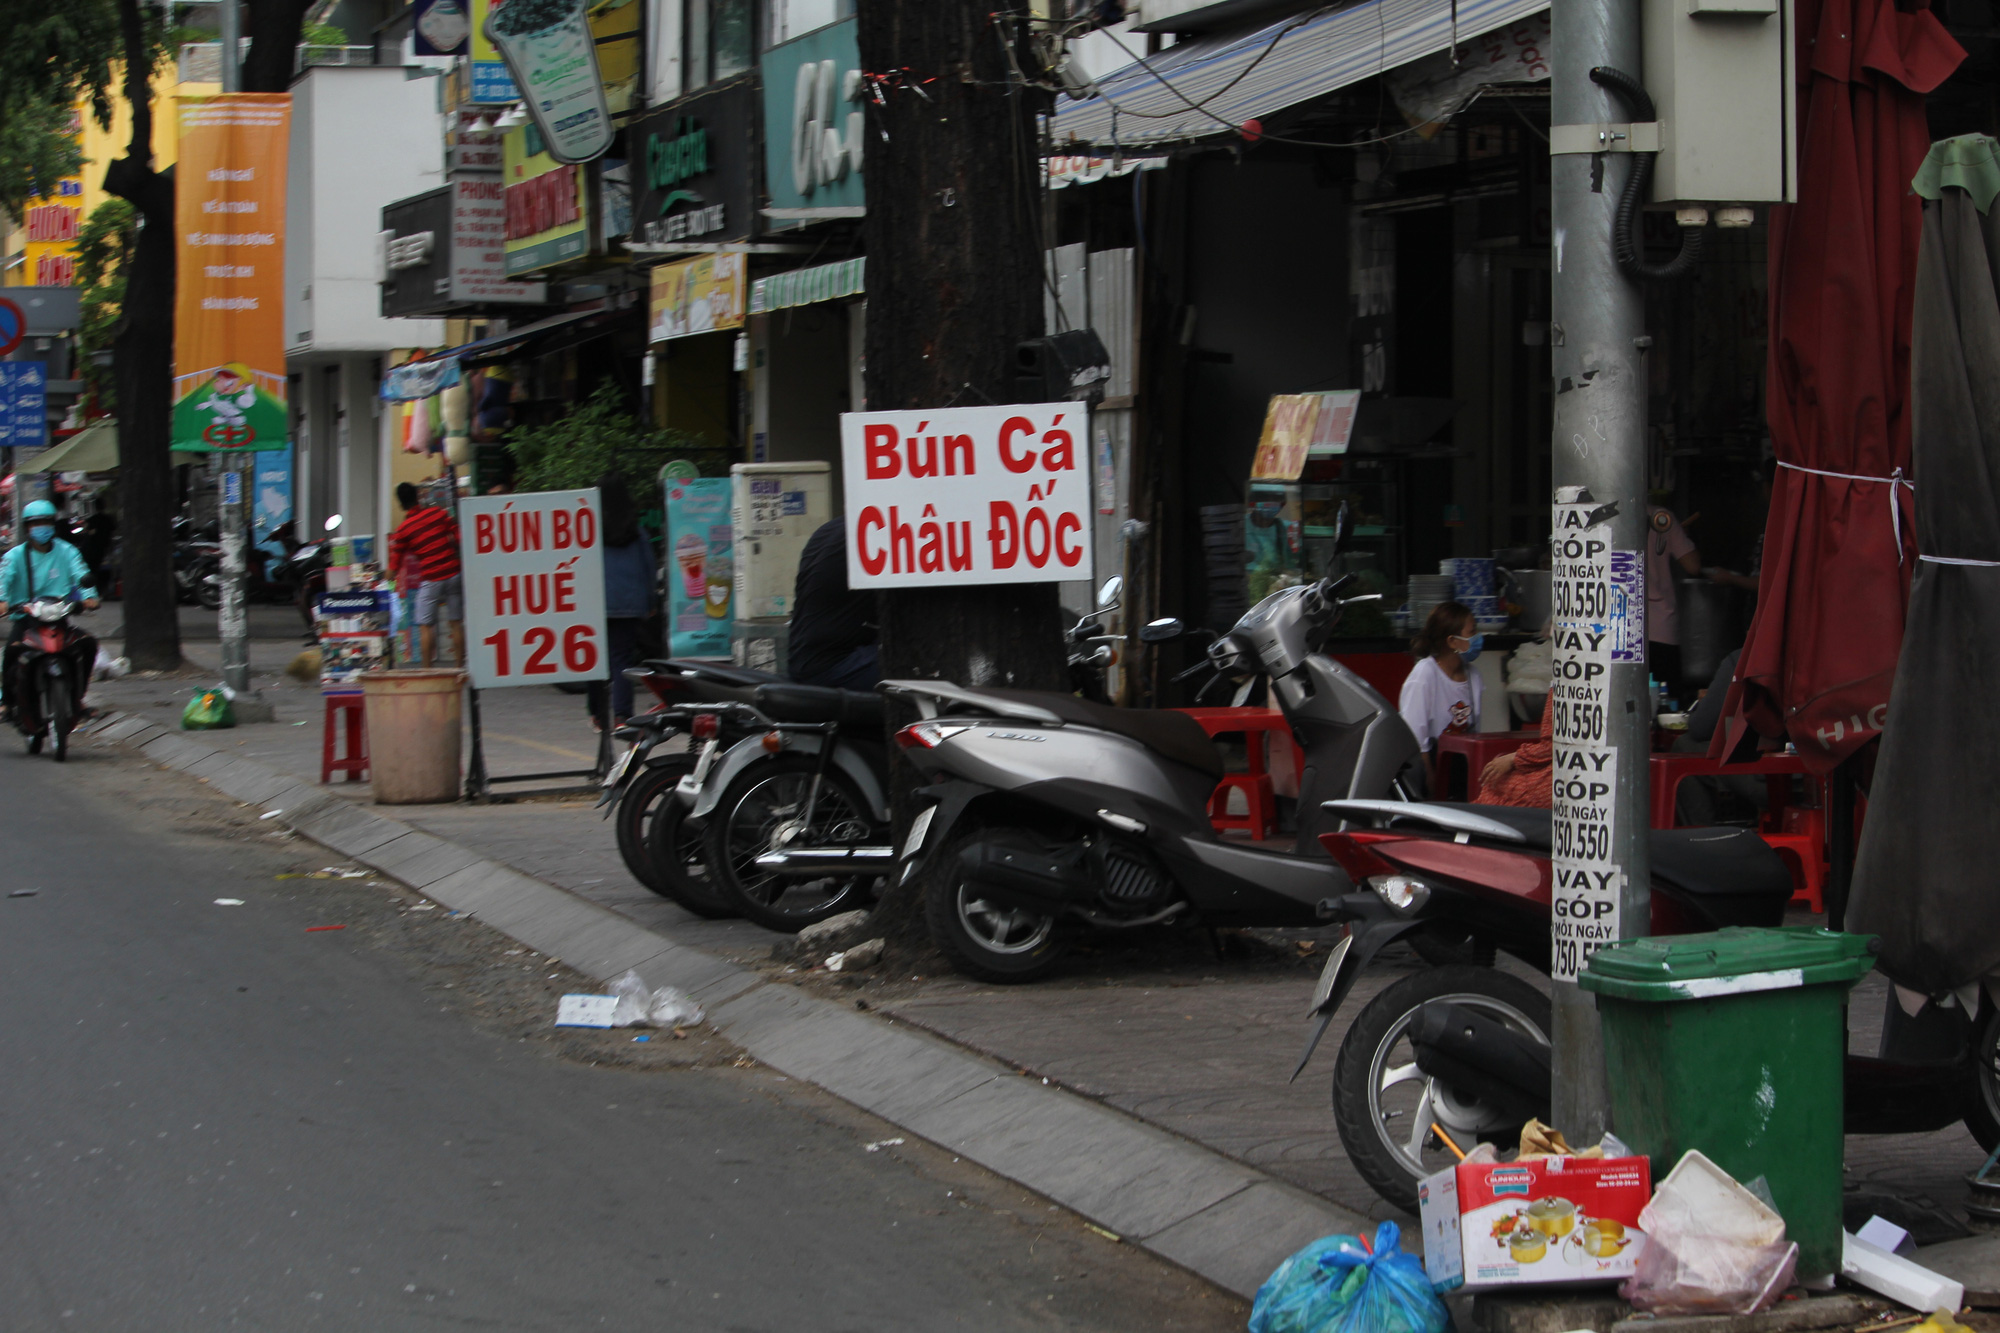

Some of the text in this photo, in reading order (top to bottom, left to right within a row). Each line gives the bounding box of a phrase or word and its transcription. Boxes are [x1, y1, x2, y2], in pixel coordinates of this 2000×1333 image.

[864, 413, 1075, 480] Bún Cá
[474, 497, 597, 555] BÚN BÒ
[857, 503, 973, 576] Châu
[1553, 533, 1606, 559] GÓP
[1569, 561, 1605, 578] NGÀY
[493, 555, 582, 616] HUẾ
[482, 624, 599, 677] 126
[1554, 629, 1607, 652] VAY
[1553, 654, 1605, 681] GÓP
[1568, 683, 1602, 701] NGÀY
[986, 731, 1047, 742] LEAD
[1555, 749, 1611, 772] VAY
[1554, 774, 1610, 801] GÓP
[1571, 802, 1608, 821] NGÀY
[1554, 819, 1609, 861] 750.550
[1557, 868, 1615, 890] VAY
[1555, 893, 1614, 919] GÓP
[1576, 921, 1613, 939] NGÀY
[1489, 1175, 1531, 1184] SUNHOUSE
